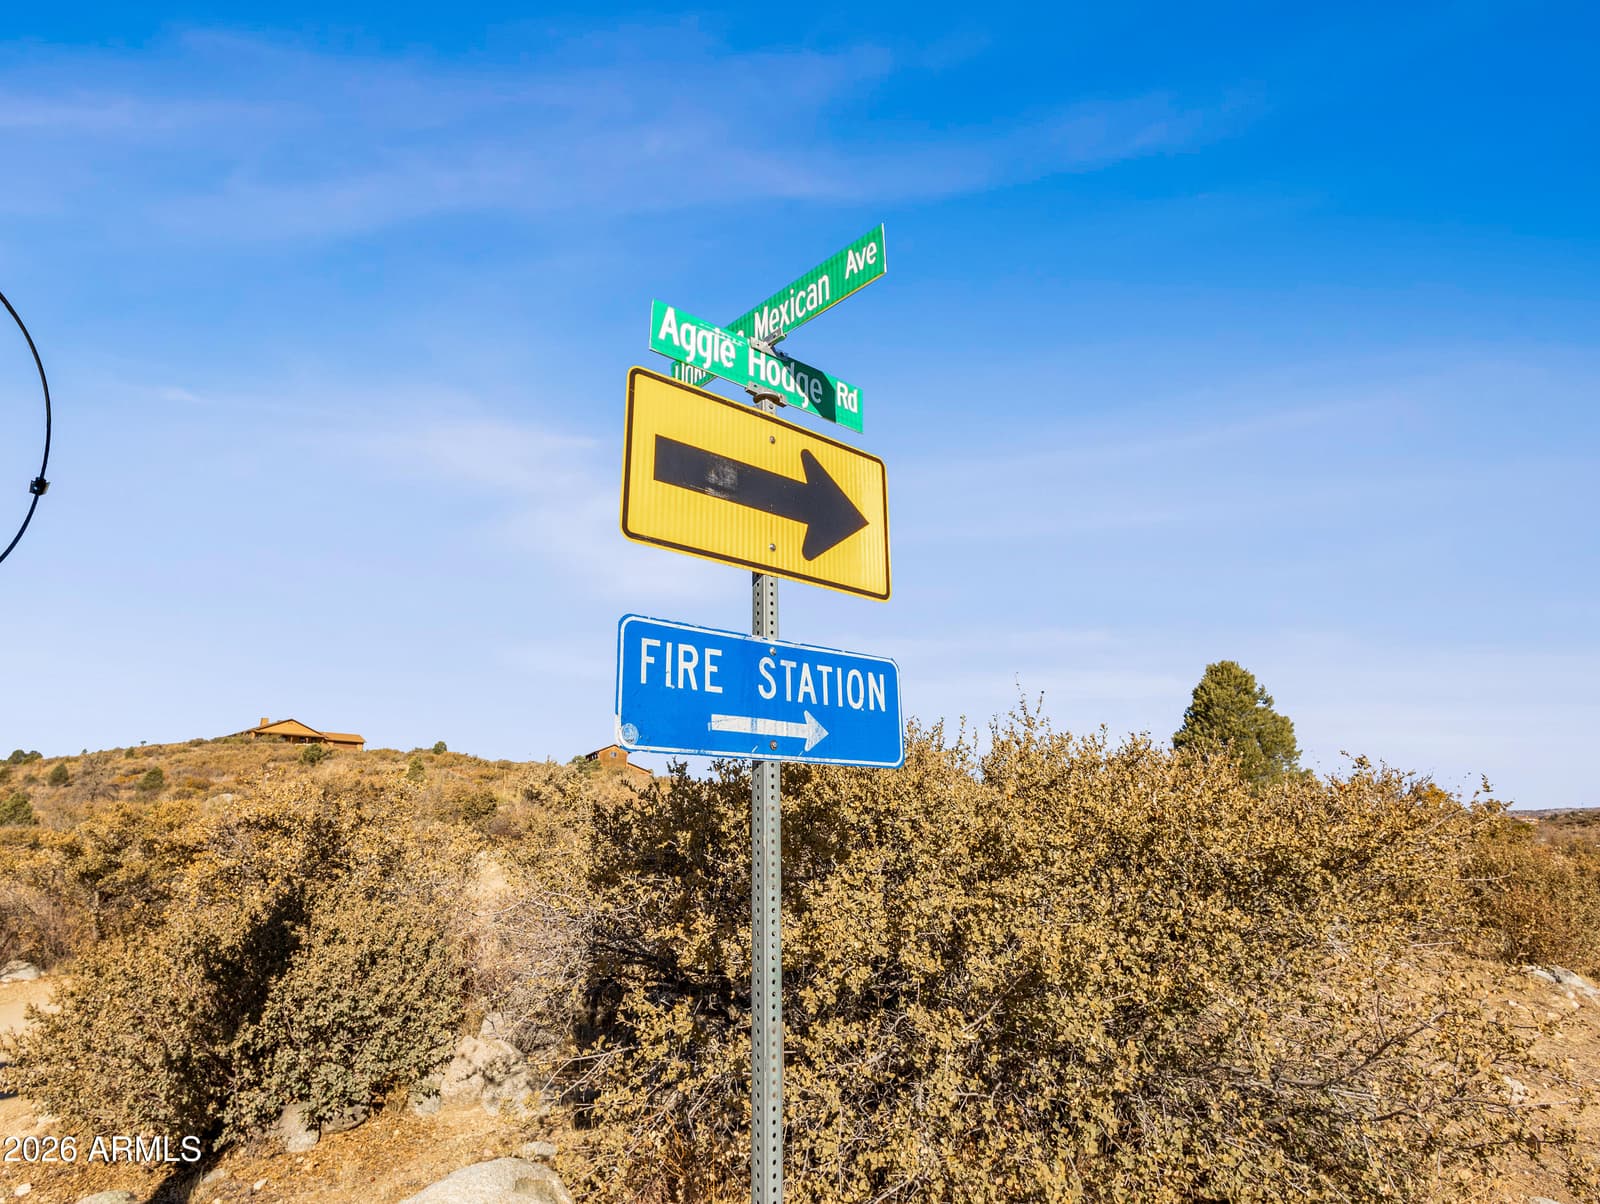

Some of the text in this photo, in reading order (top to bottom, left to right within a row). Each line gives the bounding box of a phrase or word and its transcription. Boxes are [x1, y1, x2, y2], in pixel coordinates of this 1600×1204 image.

[754, 242, 878, 341] Mexican Ave
[658, 307, 859, 413] Aggie Hodge Rd
[640, 637, 886, 712] FIRE STATION
